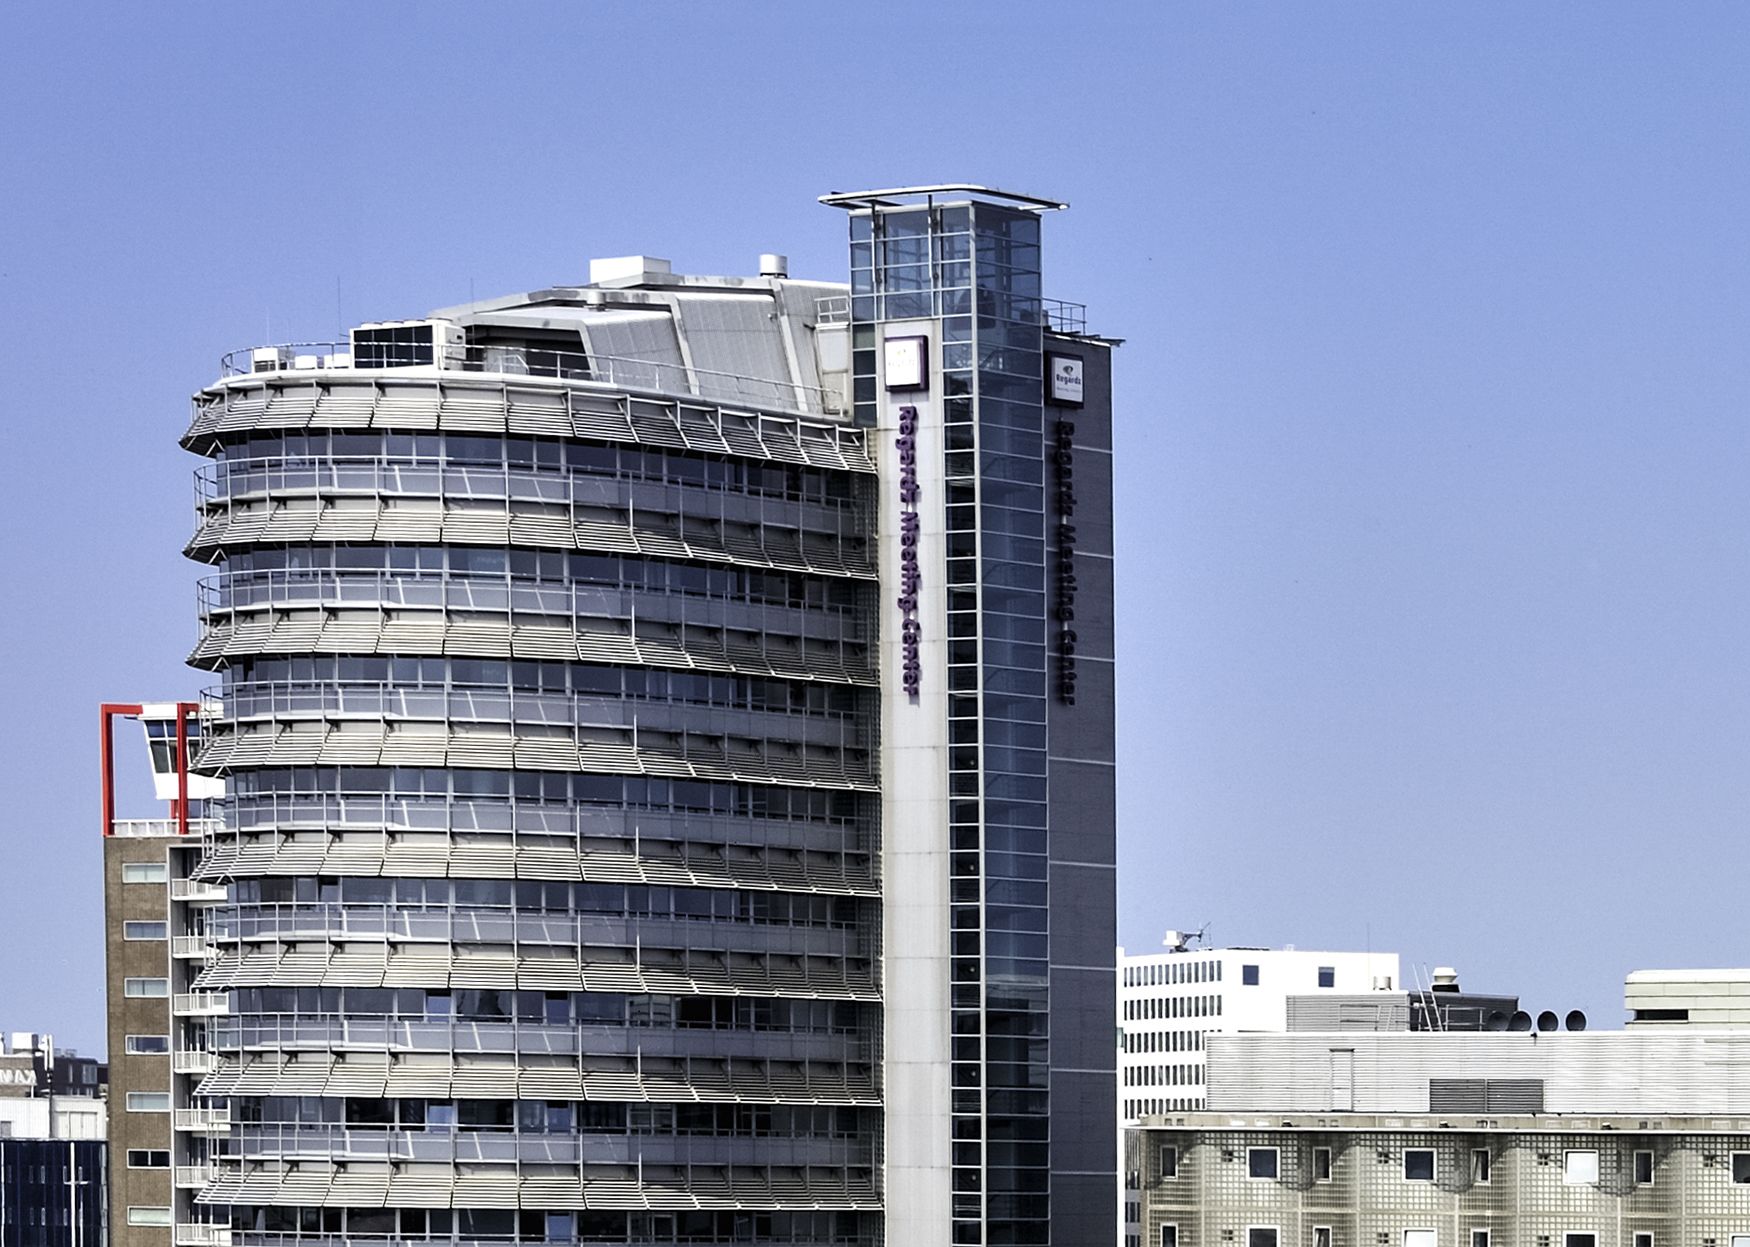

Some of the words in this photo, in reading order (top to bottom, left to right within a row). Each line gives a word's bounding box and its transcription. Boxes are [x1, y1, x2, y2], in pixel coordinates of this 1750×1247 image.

[896, 406, 919, 503] Regardz
[1057, 421, 1077, 517] Regardz
[898, 511, 920, 612] Meeting
[1057, 524, 1078, 622] Meeting
[902, 618, 920, 696] Center
[1061, 630, 1077, 706] Center
